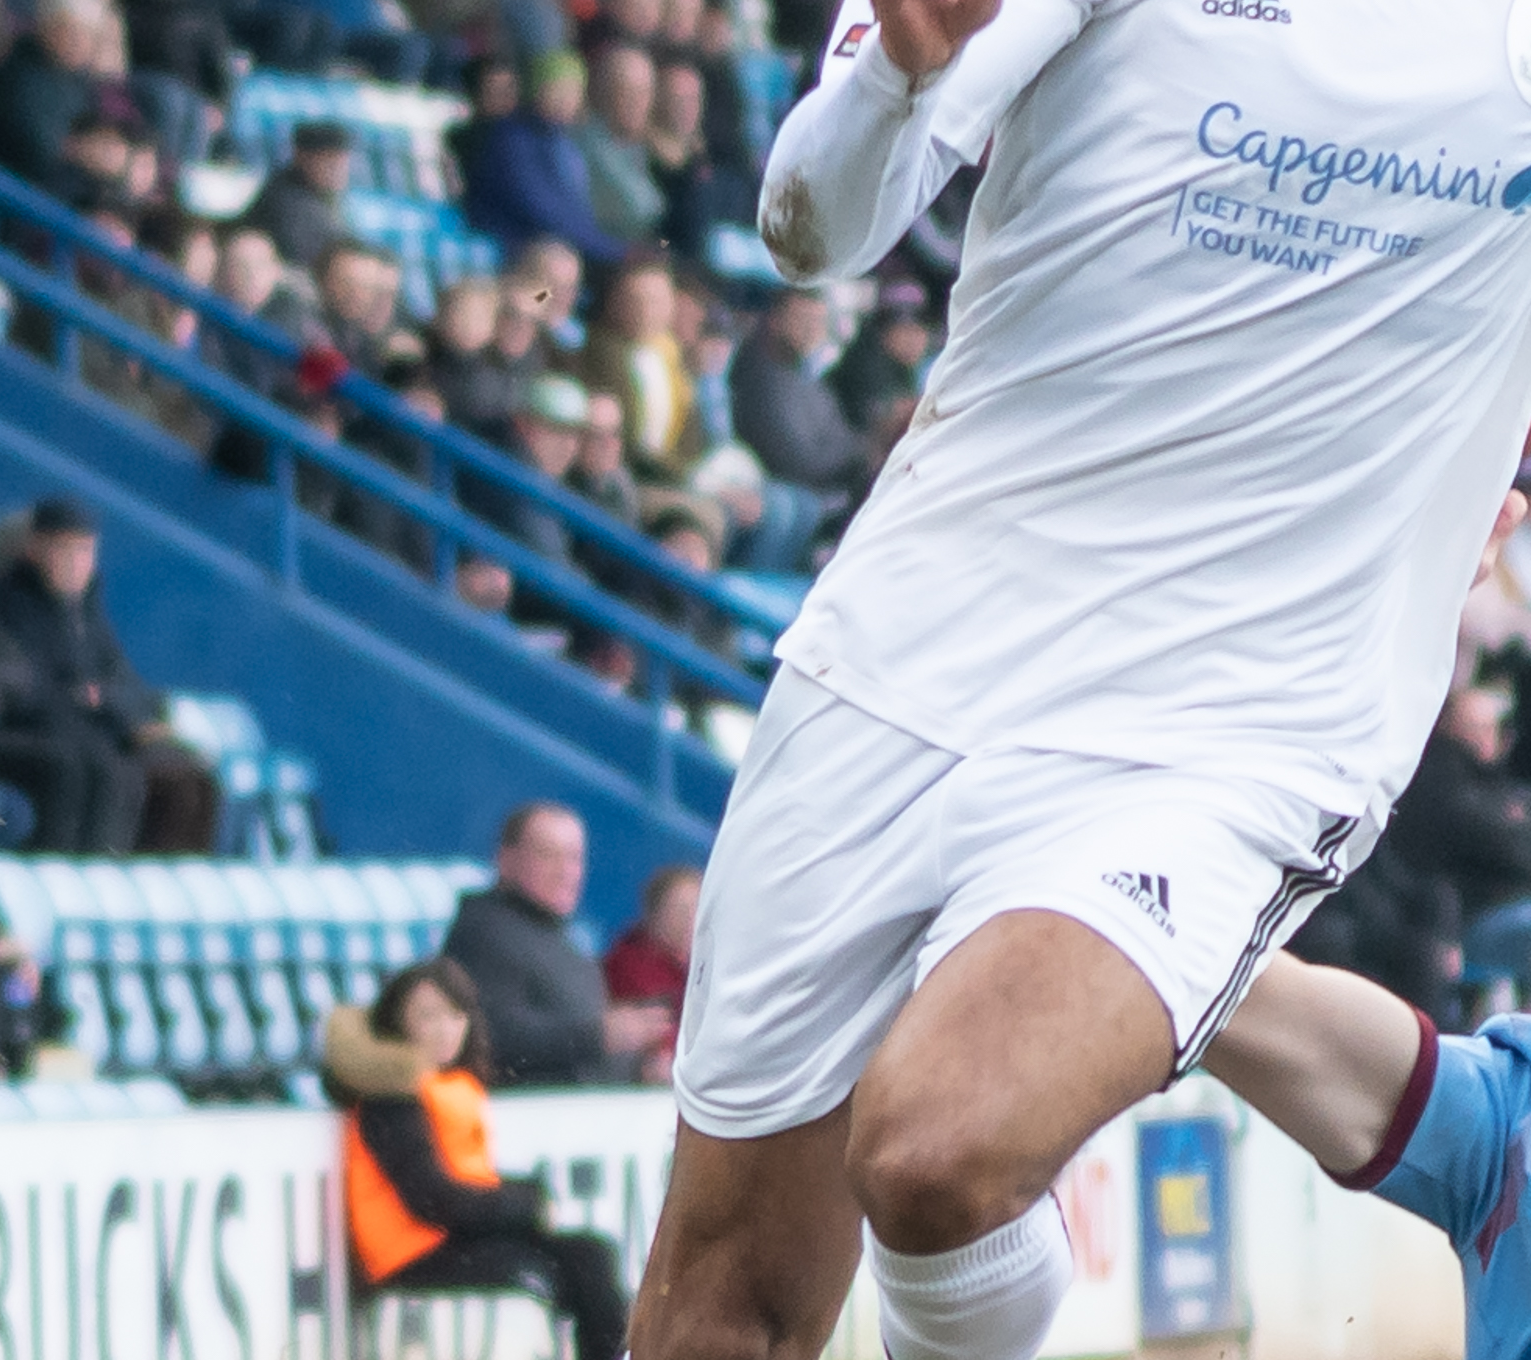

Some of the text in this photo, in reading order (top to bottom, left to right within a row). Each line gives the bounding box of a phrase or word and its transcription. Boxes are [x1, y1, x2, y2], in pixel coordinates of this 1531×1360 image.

[1197, 101, 1503, 208] Capgemini
[1185, 218, 1339, 277] YOU WANT
[1192, 189, 1425, 258] GET THE FUTURE
